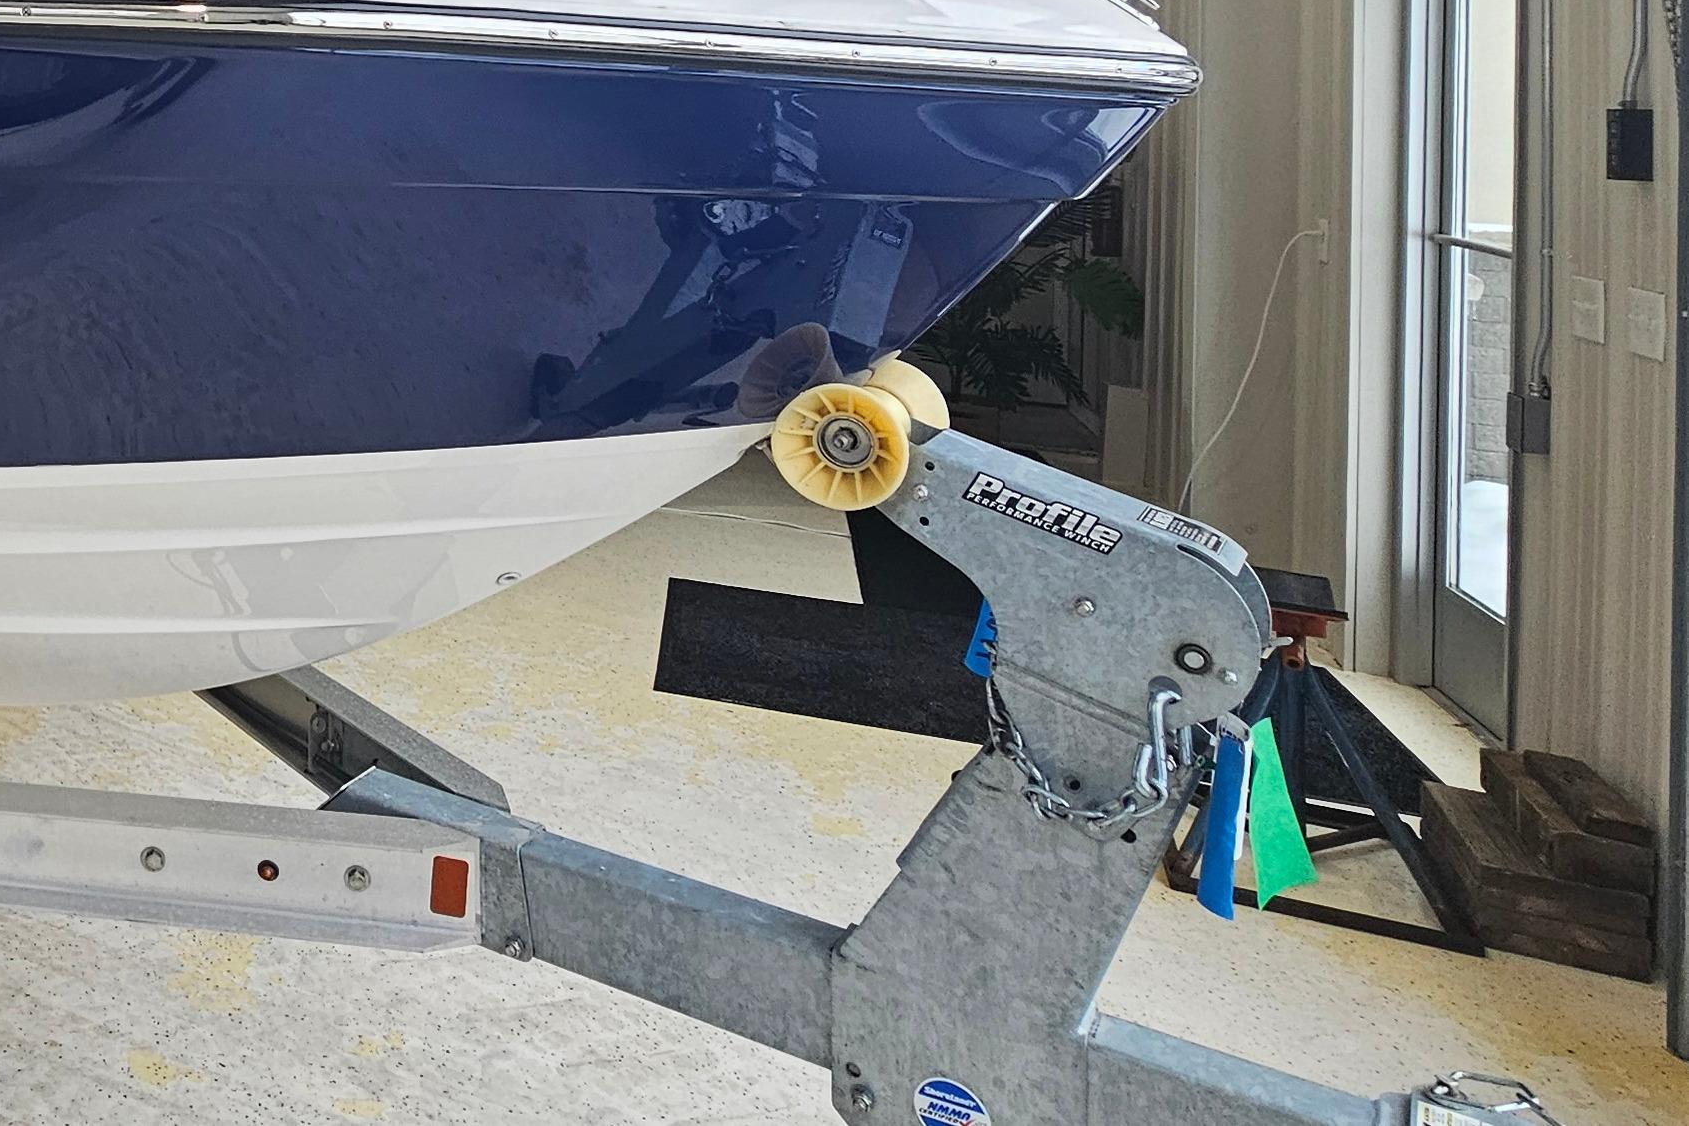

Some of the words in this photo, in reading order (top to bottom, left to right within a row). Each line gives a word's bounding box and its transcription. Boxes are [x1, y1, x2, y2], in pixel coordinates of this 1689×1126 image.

[966, 492, 1061, 534] PERFORMANCE
[1064, 529, 1111, 553] WINCH
[969, 473, 1122, 547] Profile
[919, 1107, 961, 1123] CERTIFIED
